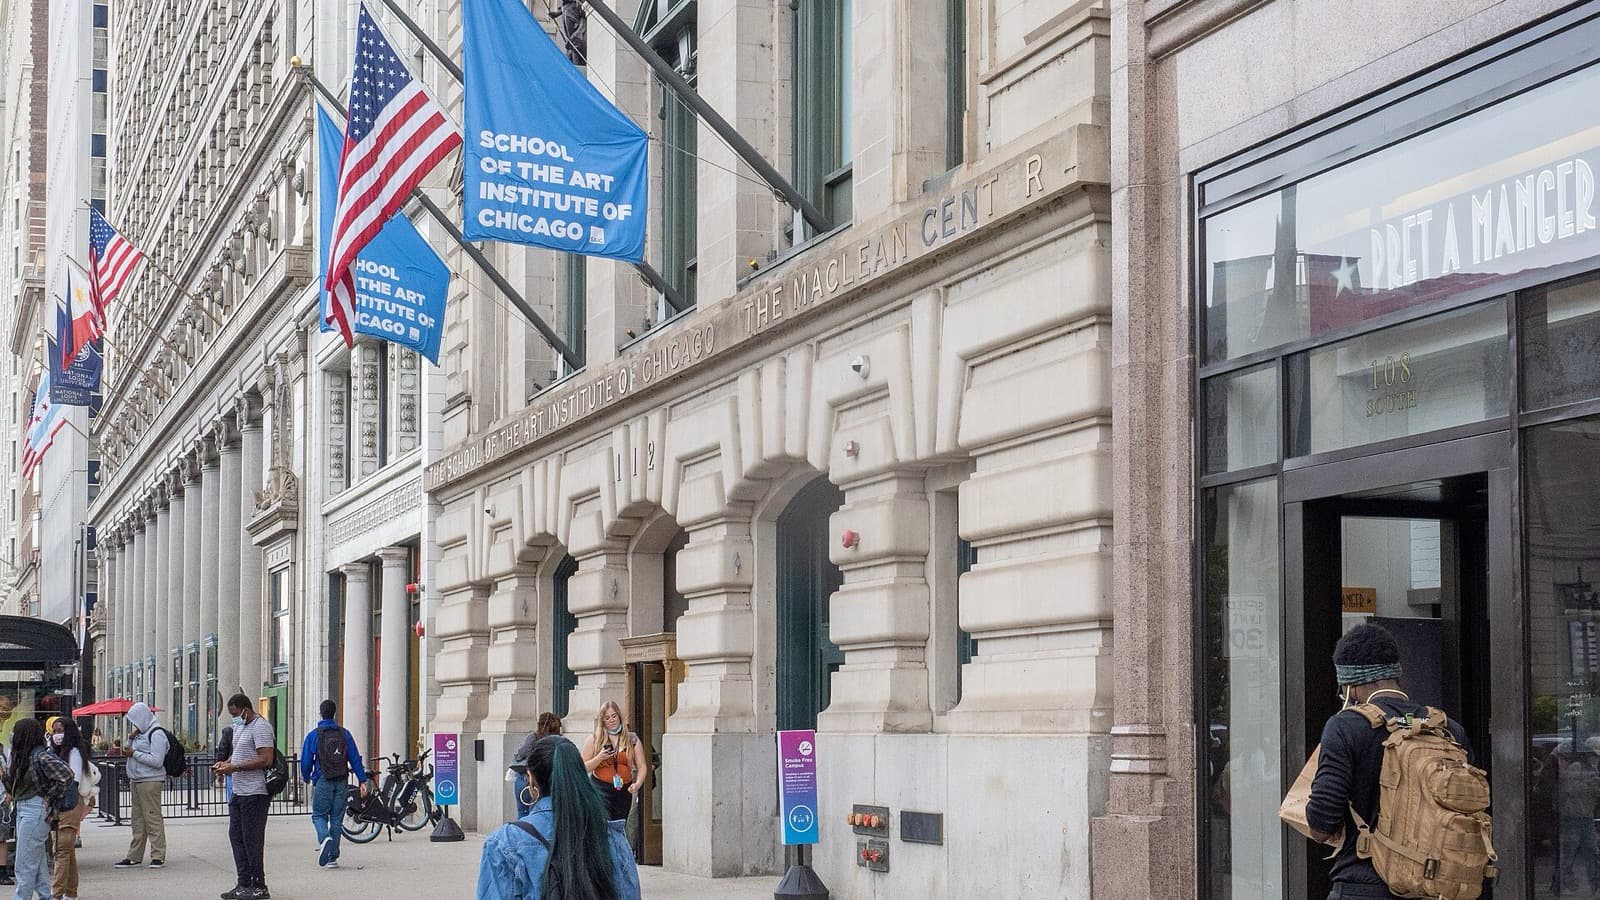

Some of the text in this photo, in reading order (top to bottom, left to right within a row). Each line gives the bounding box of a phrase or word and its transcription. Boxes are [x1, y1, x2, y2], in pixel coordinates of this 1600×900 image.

[480, 130, 574, 162] SCHOOL
[480, 157, 614, 192] OF THE ART
[479, 181, 632, 221] INSTITUTE OF
[478, 208, 583, 240] CHICAGO
[1371, 158, 1596, 295] PRET A MANGER
[744, 154, 1043, 333] THE MACLEAN CENTR
[356, 259, 400, 281] HOOL
[358, 277, 426, 306] THE ART
[355, 312, 406, 335] ICAGO
[356, 294, 435, 328] TITUTE OF
[1370, 352, 1411, 390] 108
[429, 322, 715, 485] THE SCHOOL OF THE ART INSTITUTE OF CHICAGO
[1366, 390, 1417, 417] SOUTH
[616, 440, 655, 482] 112
